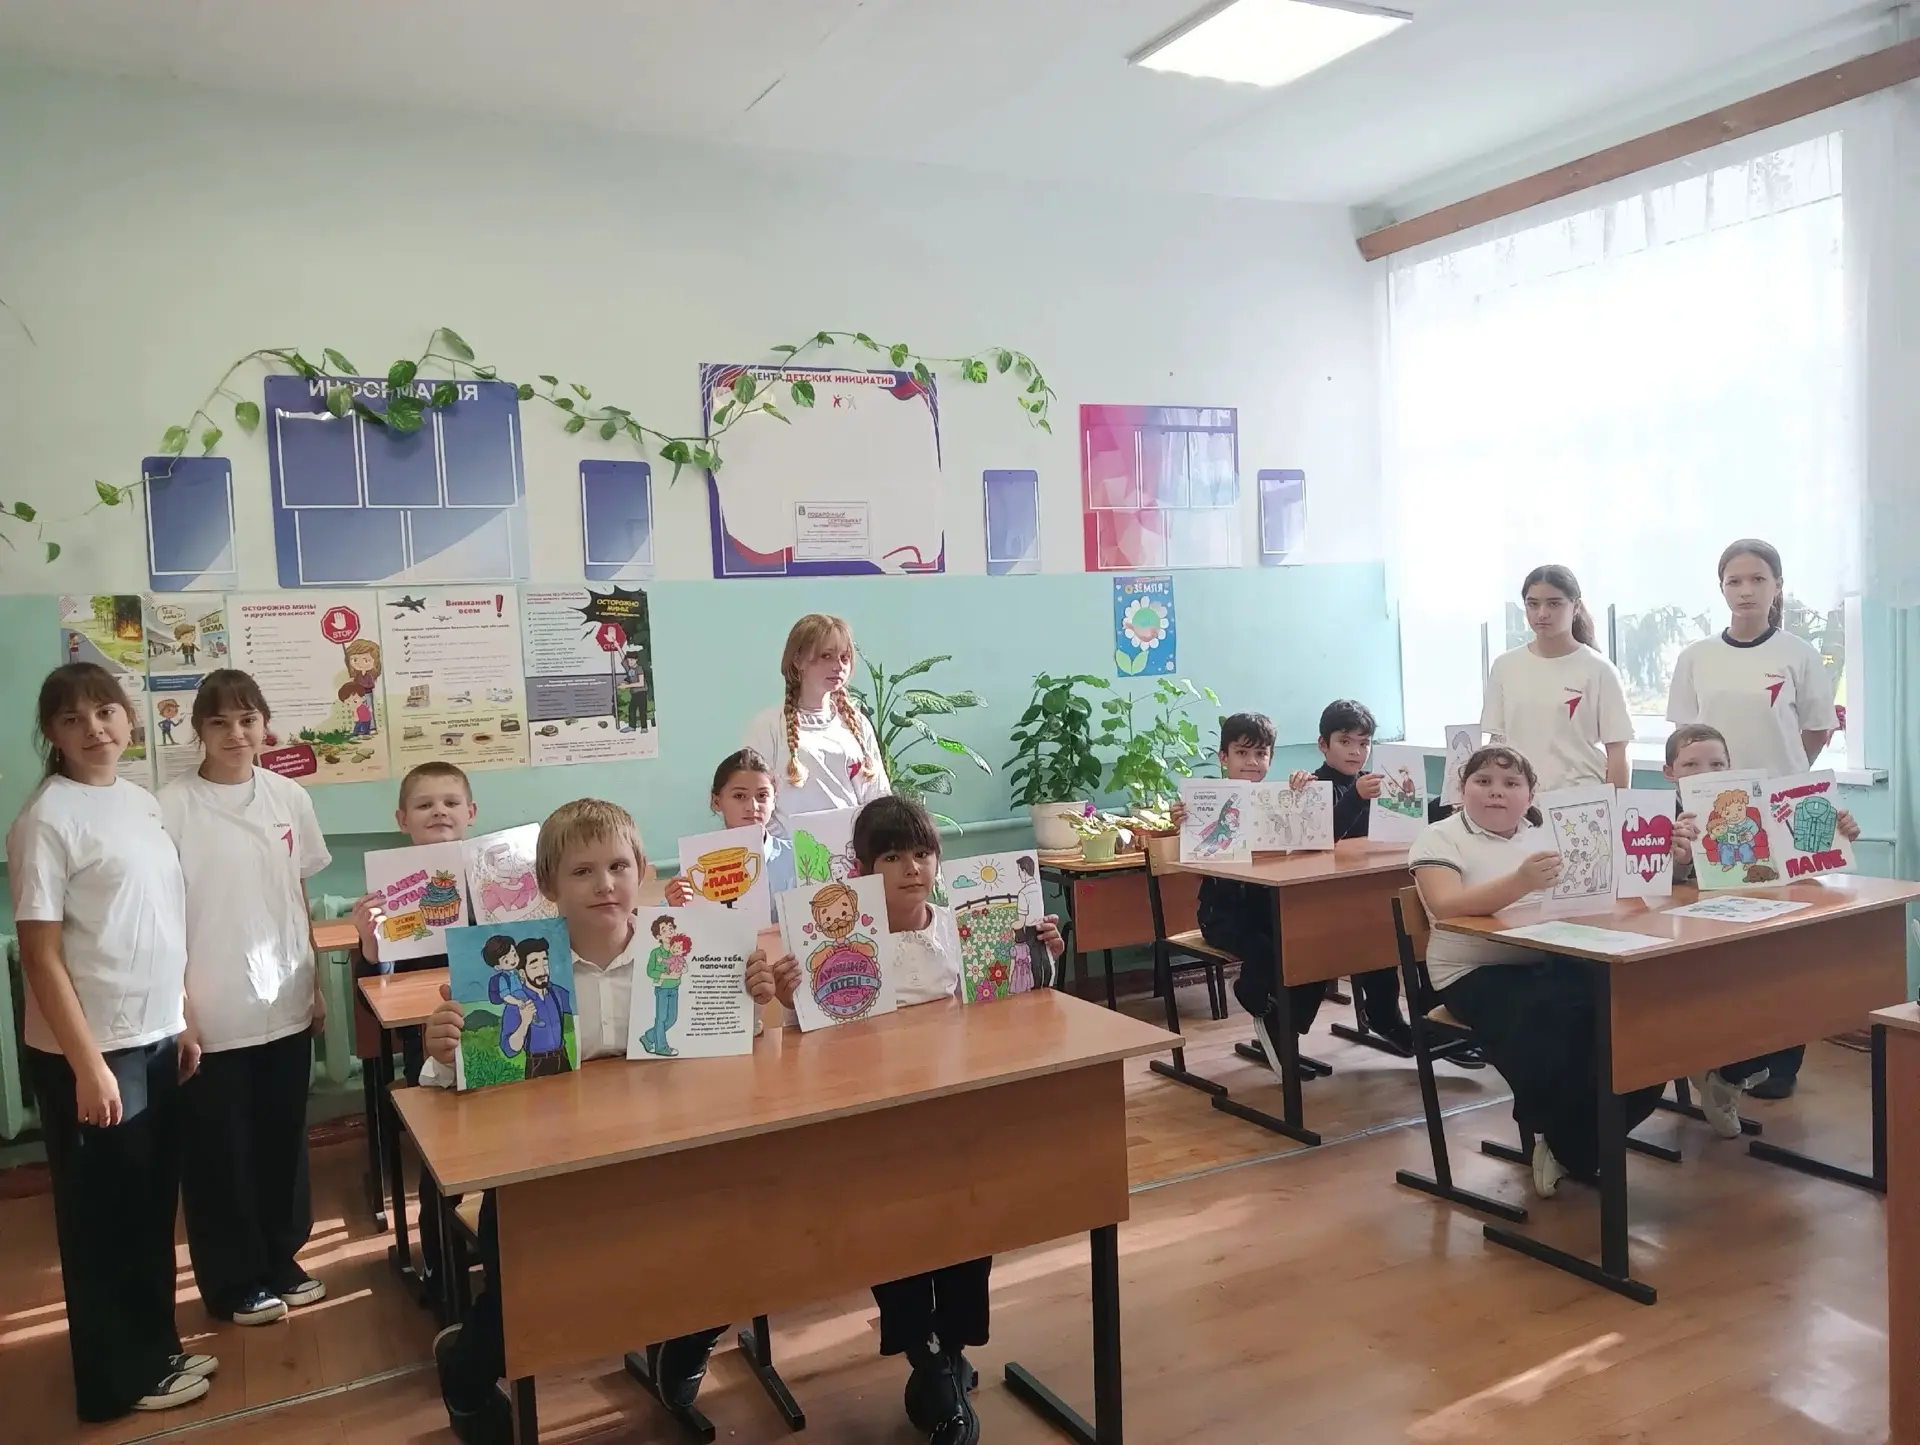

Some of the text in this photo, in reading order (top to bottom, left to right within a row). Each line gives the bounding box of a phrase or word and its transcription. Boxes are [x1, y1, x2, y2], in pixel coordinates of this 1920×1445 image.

[785, 373, 832, 384] ДЕТСКИХ
[835, 375, 894, 386] ИНИЦИАТИВ
[1133, 582, 1164, 594] ЗЕМЛЯ
[241, 603, 291, 611] ОСТОРОЖНО
[596, 598, 640, 608] ОСТОРОЖНО
[332, 629, 352, 640] STOP
[1625, 807, 1640, 833] Я
[1626, 852, 1672, 875] ПАПУ
[1785, 849, 1847, 878] ПАПЕ
[691, 954, 722, 963] Люблю
